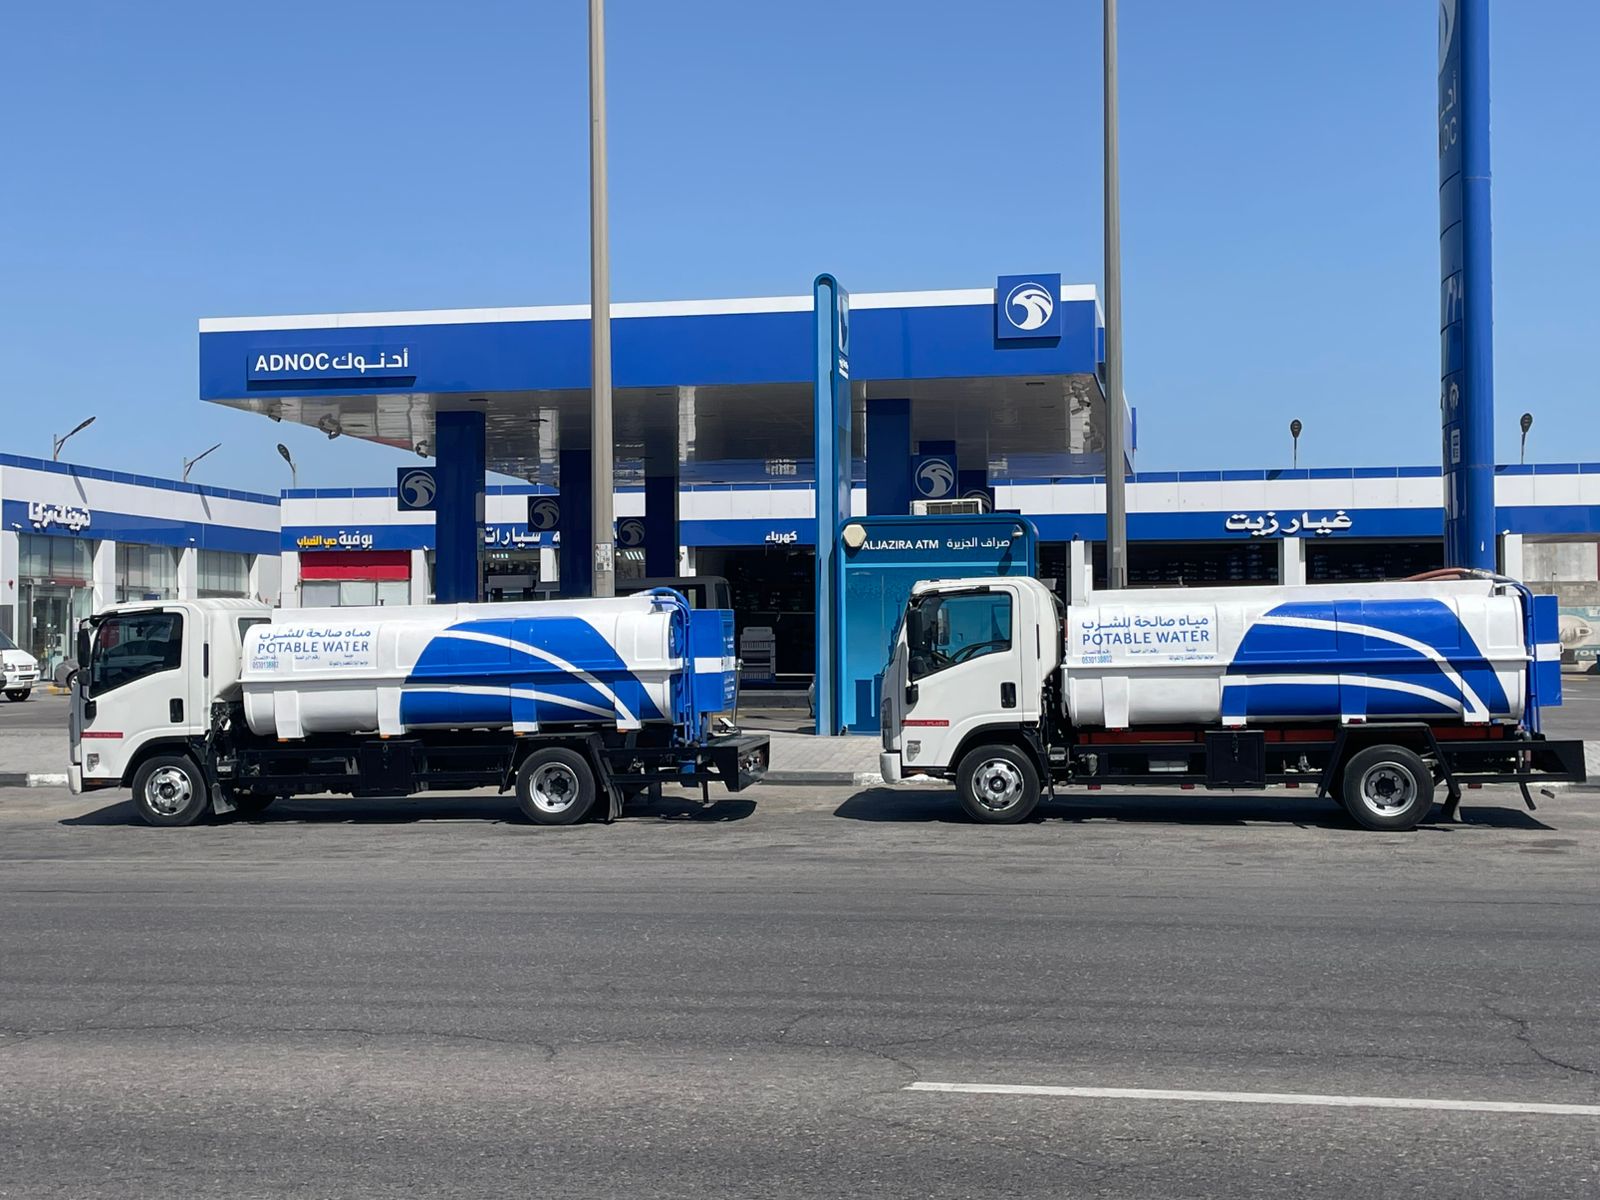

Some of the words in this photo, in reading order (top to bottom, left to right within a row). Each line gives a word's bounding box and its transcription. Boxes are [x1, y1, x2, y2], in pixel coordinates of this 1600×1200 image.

[254, 352, 330, 372] ADNOC
[332, 347, 409, 373] أدنوك
[1225, 511, 1280, 536] زيت
[1281, 510, 1353, 535] غيار
[338, 530, 373, 549] بوفية
[484, 526, 541, 548] سيارات
[765, 530, 798, 544] كهرباء
[861, 540, 913, 550] ALJAZIRA
[915, 539, 939, 549] ATM
[946, 537, 978, 549] الجزيرة
[980, 536, 1011, 548] صراف
[1081, 616, 1131, 632] للشرب
[1134, 615, 1175, 628] صالحة
[1178, 614, 1210, 629] مياه
[259, 628, 305, 642] للشرب
[306, 627, 343, 638] صالحة
[1082, 632, 1152, 646] POTABLE
[1155, 629, 1210, 644] WATER
[257, 641, 319, 654] POTABLE
[322, 640, 369, 653] WATER
